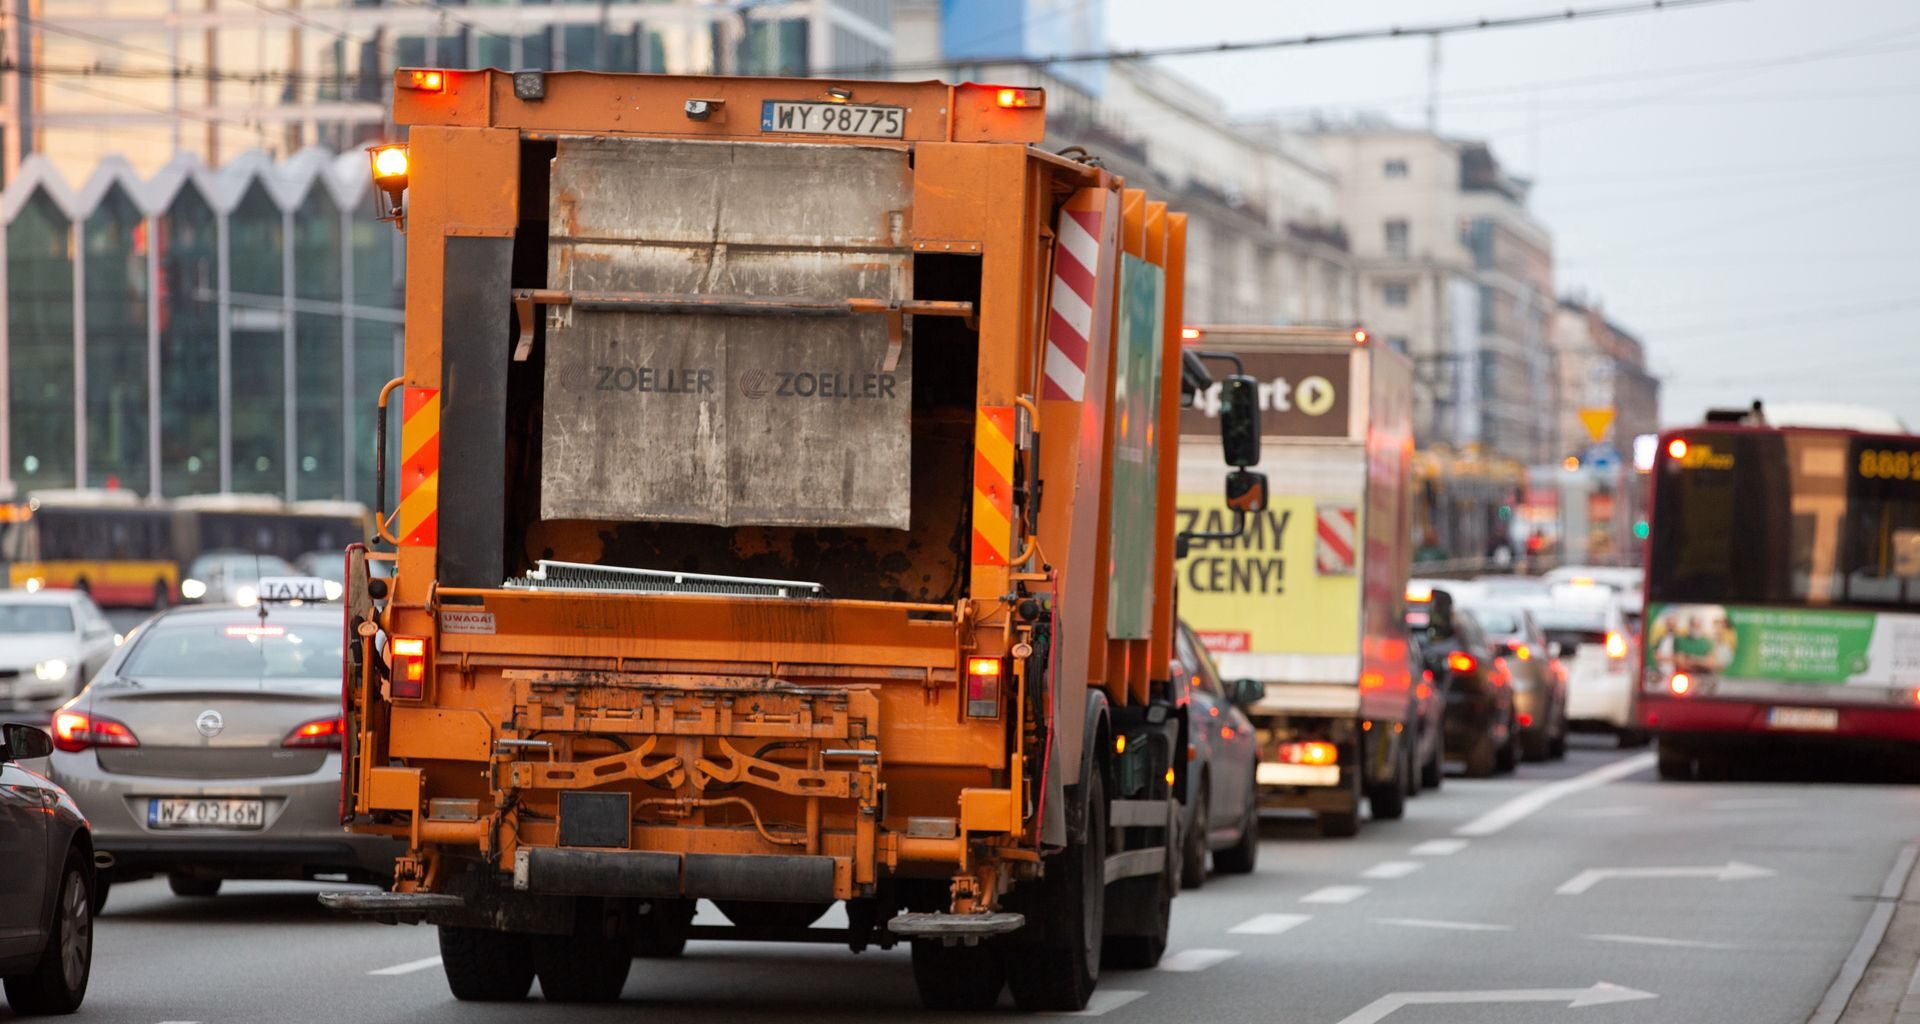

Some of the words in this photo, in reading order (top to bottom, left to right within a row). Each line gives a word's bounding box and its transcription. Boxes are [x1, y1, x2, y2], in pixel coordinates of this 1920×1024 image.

[778, 106, 812, 129] WY
[822, 107, 899, 134] 98775
[595, 366, 715, 394] ZOELLER
[775, 371, 896, 399] ZOELLER
[1188, 557, 1285, 594] CENY!
[265, 583, 315, 599] TAXI
[444, 614, 492, 623] UWAGA!
[161, 803, 189, 820] WZ
[197, 803, 259, 822] 0316W
